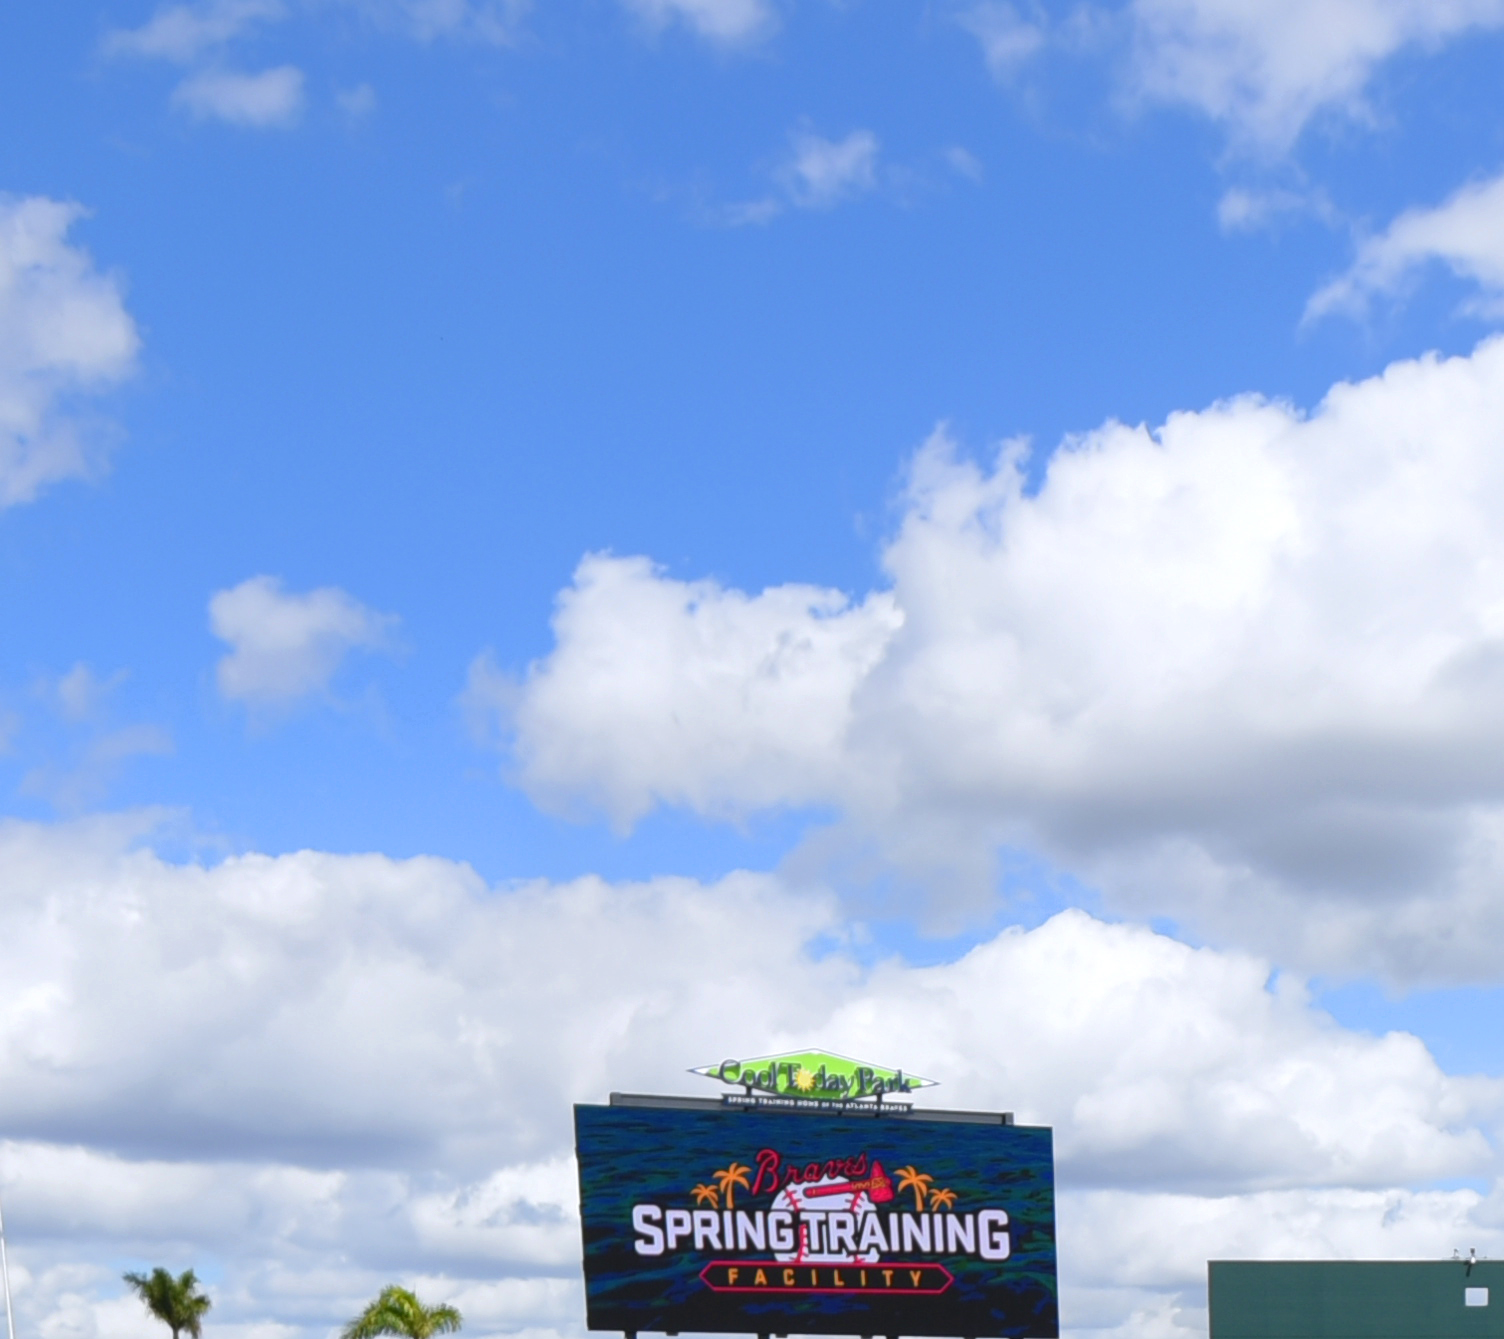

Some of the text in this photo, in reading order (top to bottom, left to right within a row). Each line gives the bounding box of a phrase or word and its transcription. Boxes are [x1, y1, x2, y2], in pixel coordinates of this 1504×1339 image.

[858, 1067, 911, 1093] Park
[752, 1149, 868, 1195] Braves
[632, 1204, 1011, 1261] SPRING TRAINING
[728, 1267, 922, 1288] FACILITY
